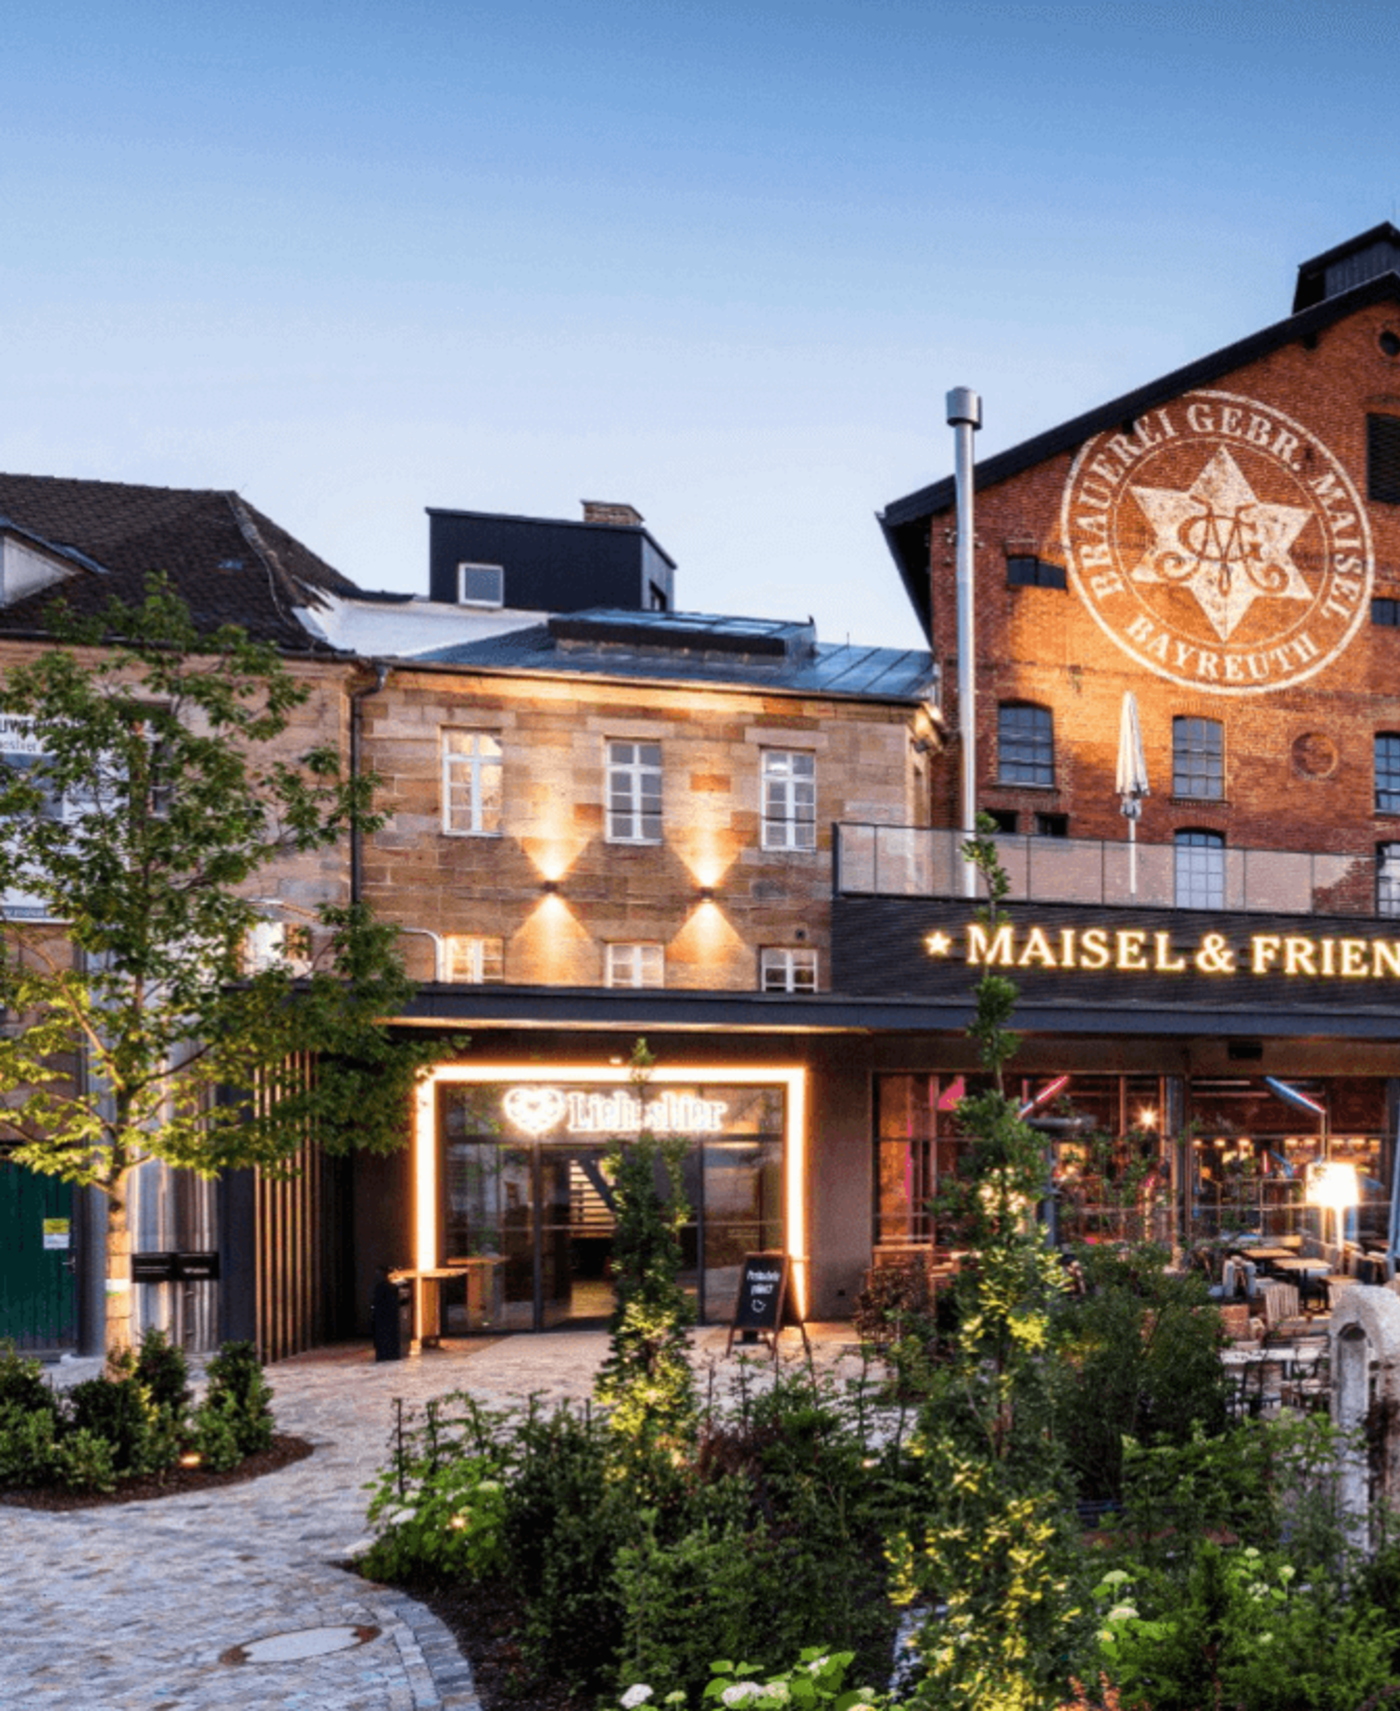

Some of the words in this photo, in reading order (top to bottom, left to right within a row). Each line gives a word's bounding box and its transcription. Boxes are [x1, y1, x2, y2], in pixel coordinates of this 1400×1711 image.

[1076, 407, 1180, 600] BRAUEREI
[1186, 402, 1303, 471] GEBR.
[1308, 472, 1363, 620] MAISEL
[1124, 613, 1320, 681] BAYREUTH
[966, 923, 1187, 971] MAISEL
[1195, 932, 1236, 972] &
[567, 1089, 728, 1132] Liebsbier
